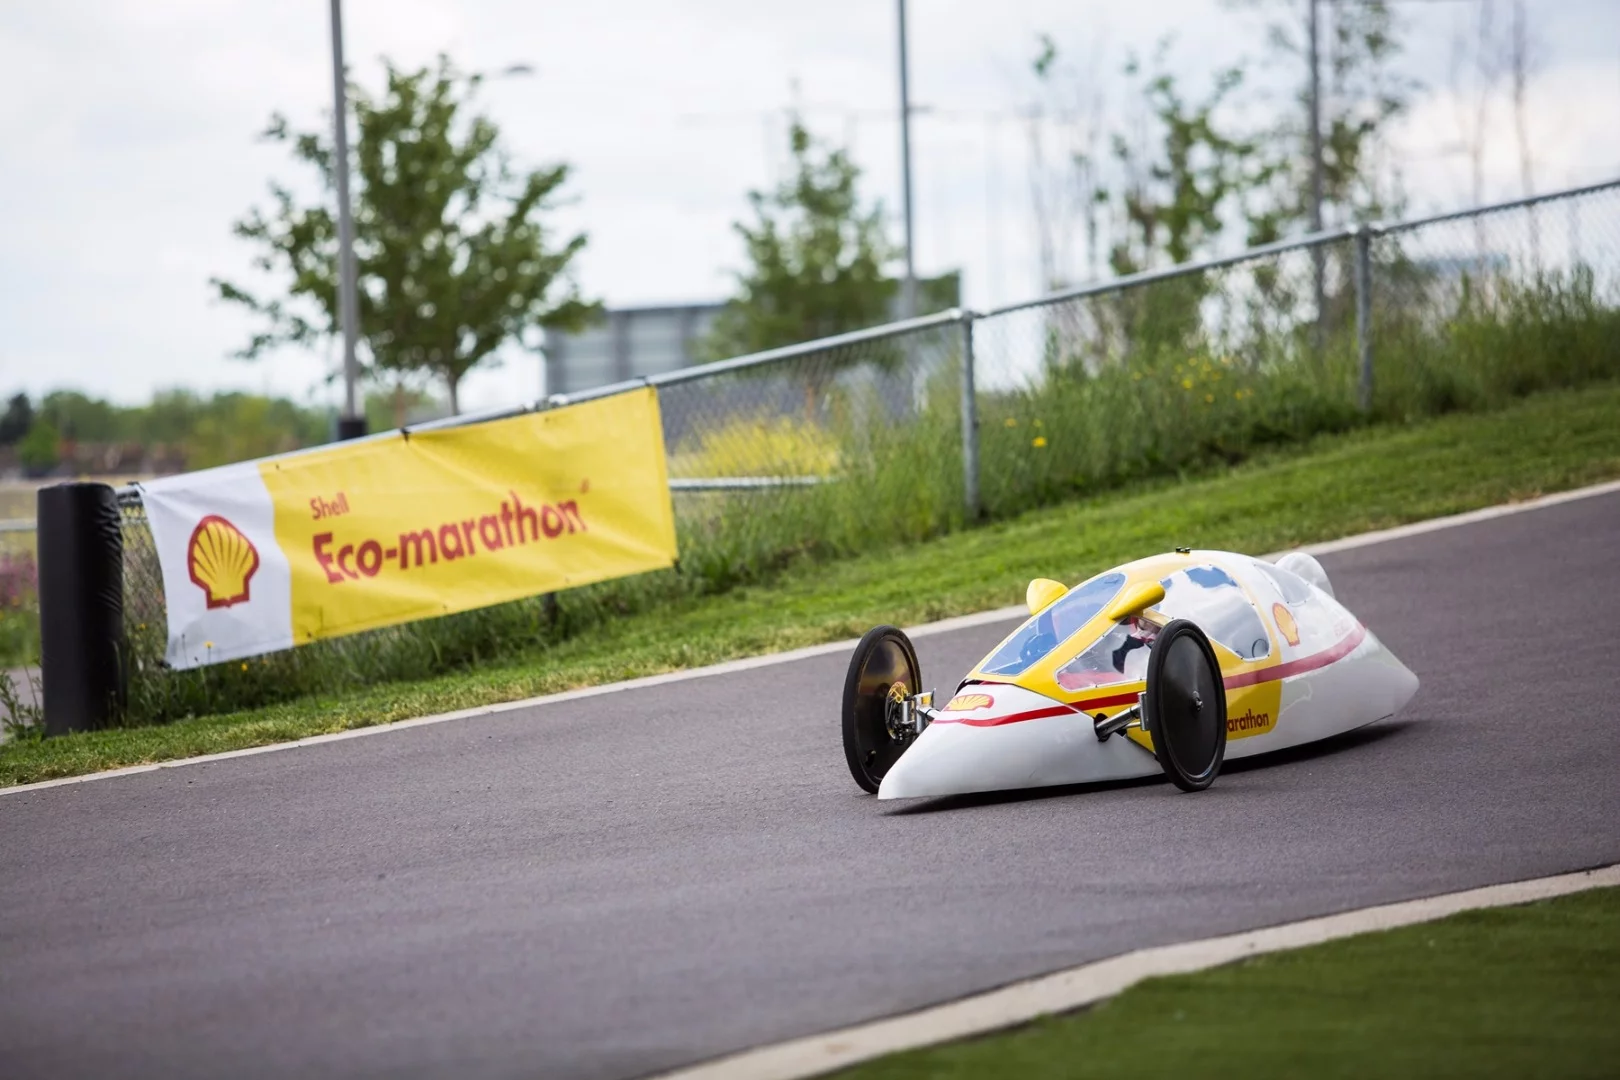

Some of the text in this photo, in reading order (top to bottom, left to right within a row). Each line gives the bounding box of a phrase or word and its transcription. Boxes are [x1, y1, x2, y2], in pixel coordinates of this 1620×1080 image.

[310, 492, 350, 520] Shell
[312, 489, 588, 584] Eco-marathon
[1226, 708, 1269, 732] arathon
